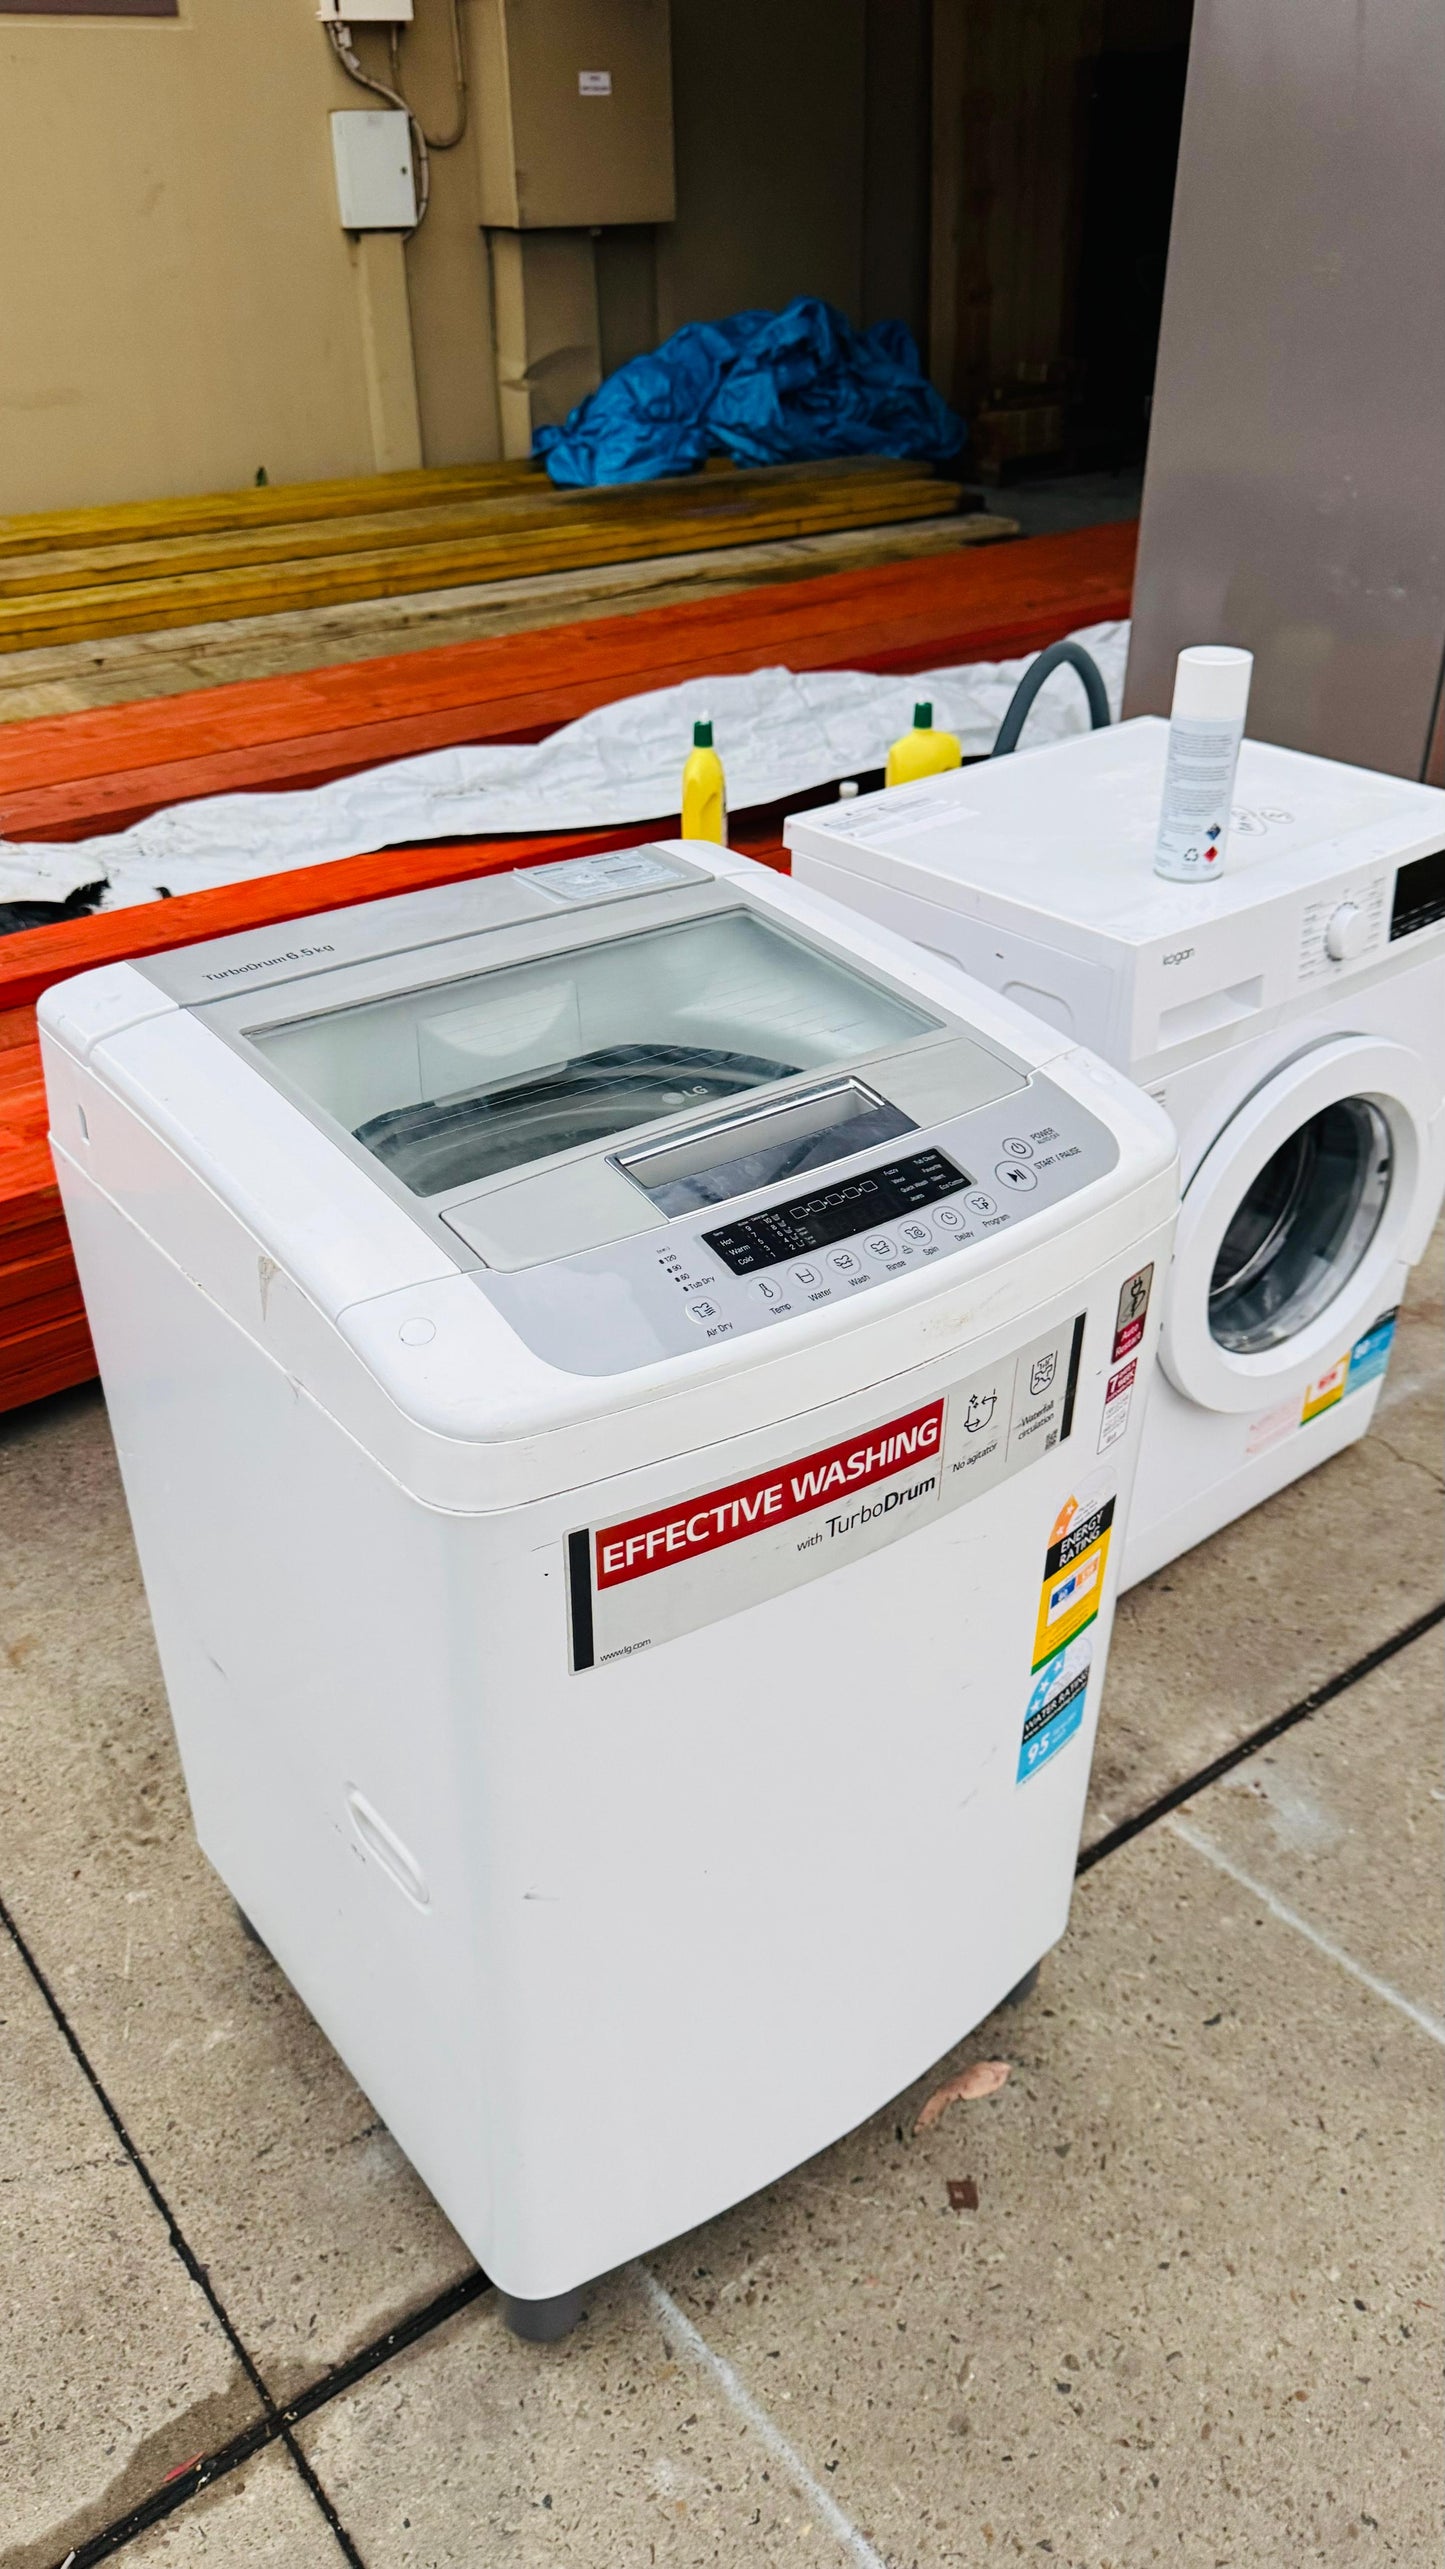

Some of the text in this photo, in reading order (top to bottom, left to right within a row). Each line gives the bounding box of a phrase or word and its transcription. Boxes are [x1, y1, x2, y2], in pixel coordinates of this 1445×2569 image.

[202, 956, 287, 980] TurboDrum
[682, 1085, 709, 1097] LG
[1030, 1127, 1055, 1140] POWER
[1033, 1156, 1056, 1169] START
[1058, 1146, 1082, 1158] PAUSE
[982, 1214, 1011, 1228] Program
[720, 1238, 734, 1247] Hot
[954, 1230, 975, 1242] Delay
[728, 1244, 751, 1256] Warm
[922, 1245, 940, 1256] Spin
[664, 1254, 677, 1262] 120
[738, 1255, 754, 1265] Cold
[885, 1260, 907, 1272] Rinse
[688, 1276, 715, 1290] Tub Dry
[848, 1274, 871, 1287] Wash
[807, 1287, 833, 1302] Water
[769, 1303, 792, 1315] Temp
[706, 1322, 733, 1337] Air Dry
[1120, 1323, 1139, 1342] Auto
[1109, 1375, 1119, 1393] 7
[1020, 1400, 1054, 1427] Waterfall
[1018, 1413, 1054, 1440] circulation
[952, 1442, 998, 1473] No agitator
[603, 1417, 938, 1574] EFFECTIVE WASHING
[796, 1476, 935, 1551] with TurboDrum
[1060, 1509, 1103, 1553] ENERGY
[1059, 1525, 1101, 1567] RATING
[600, 1639, 651, 1661] www.lg.com
[1025, 1700, 1057, 1731] WATER
[1027, 1732, 1051, 1765] 95
